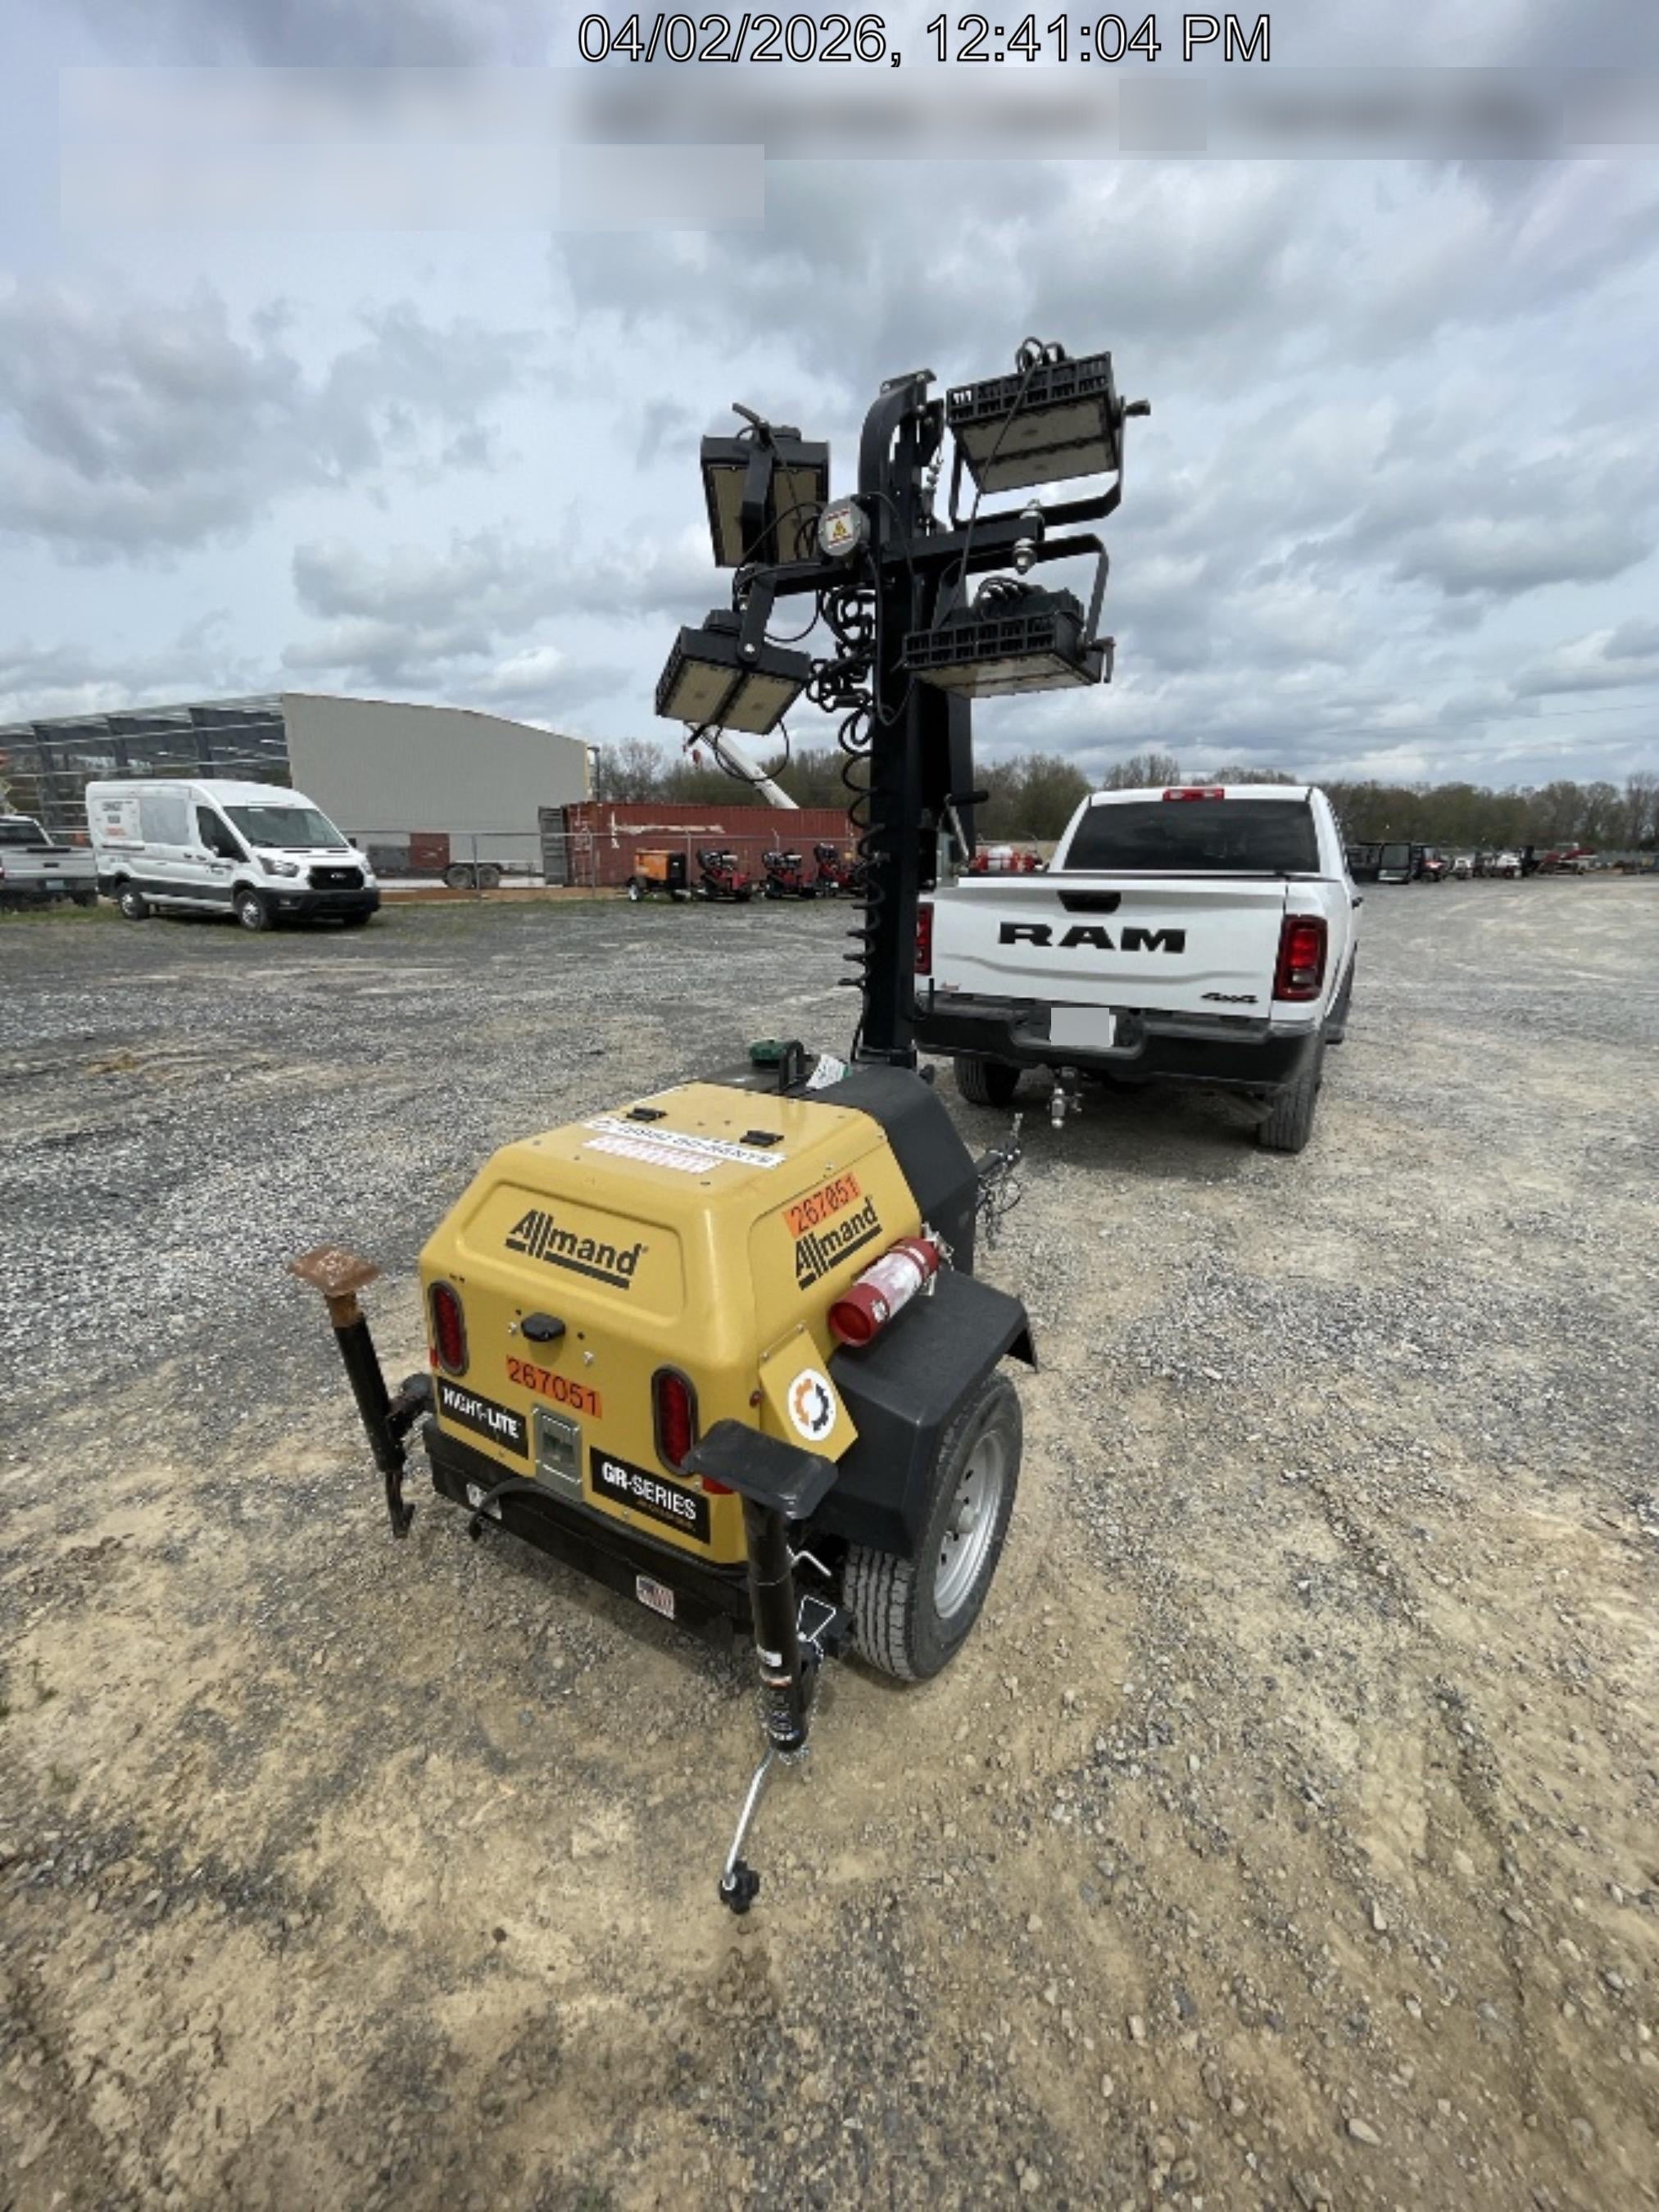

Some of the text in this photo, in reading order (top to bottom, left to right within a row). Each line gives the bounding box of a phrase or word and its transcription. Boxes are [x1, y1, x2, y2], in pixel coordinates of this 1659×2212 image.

[999, 922, 1185, 954] RAM
[507, 1208, 643, 1277] Allmand
[796, 1195, 879, 1280] Allmand
[507, 1358, 597, 1417] 267051
[601, 1461, 697, 1521] GR-SERIES
